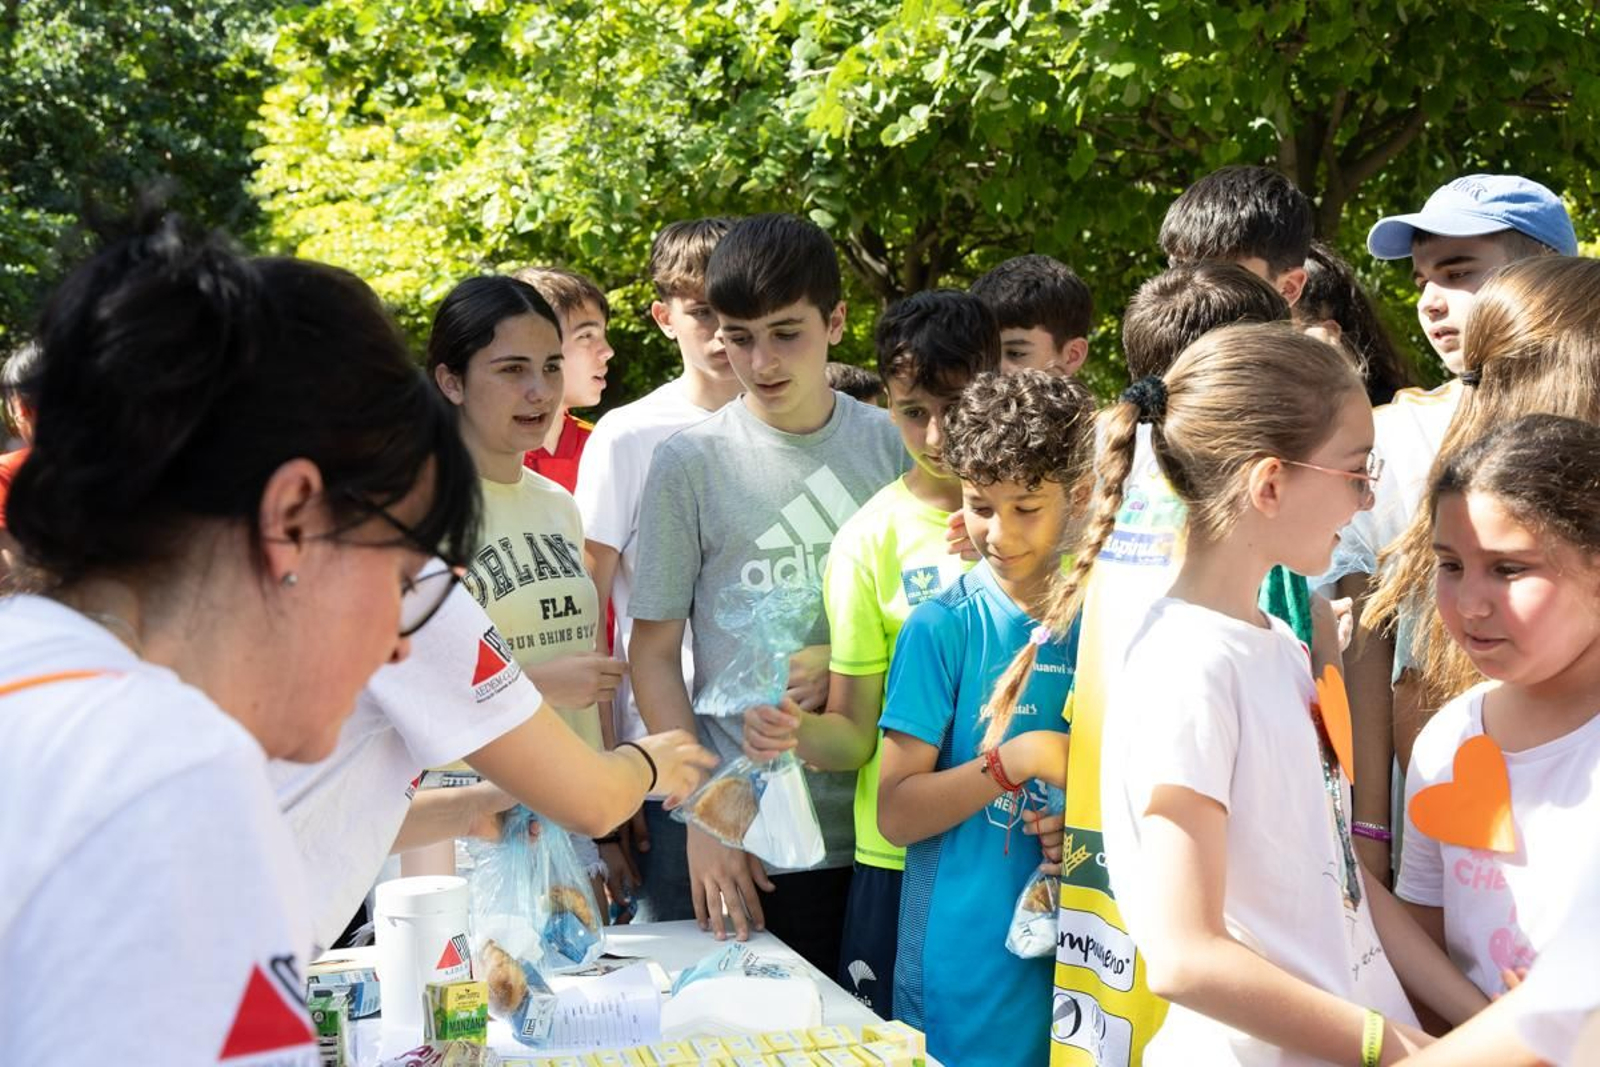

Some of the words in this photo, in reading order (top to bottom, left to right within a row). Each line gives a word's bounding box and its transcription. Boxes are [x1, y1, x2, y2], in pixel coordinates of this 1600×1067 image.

[461, 532, 586, 608] ORLAN
[539, 595, 582, 620] FLA.
[539, 628, 573, 646] SHINE
